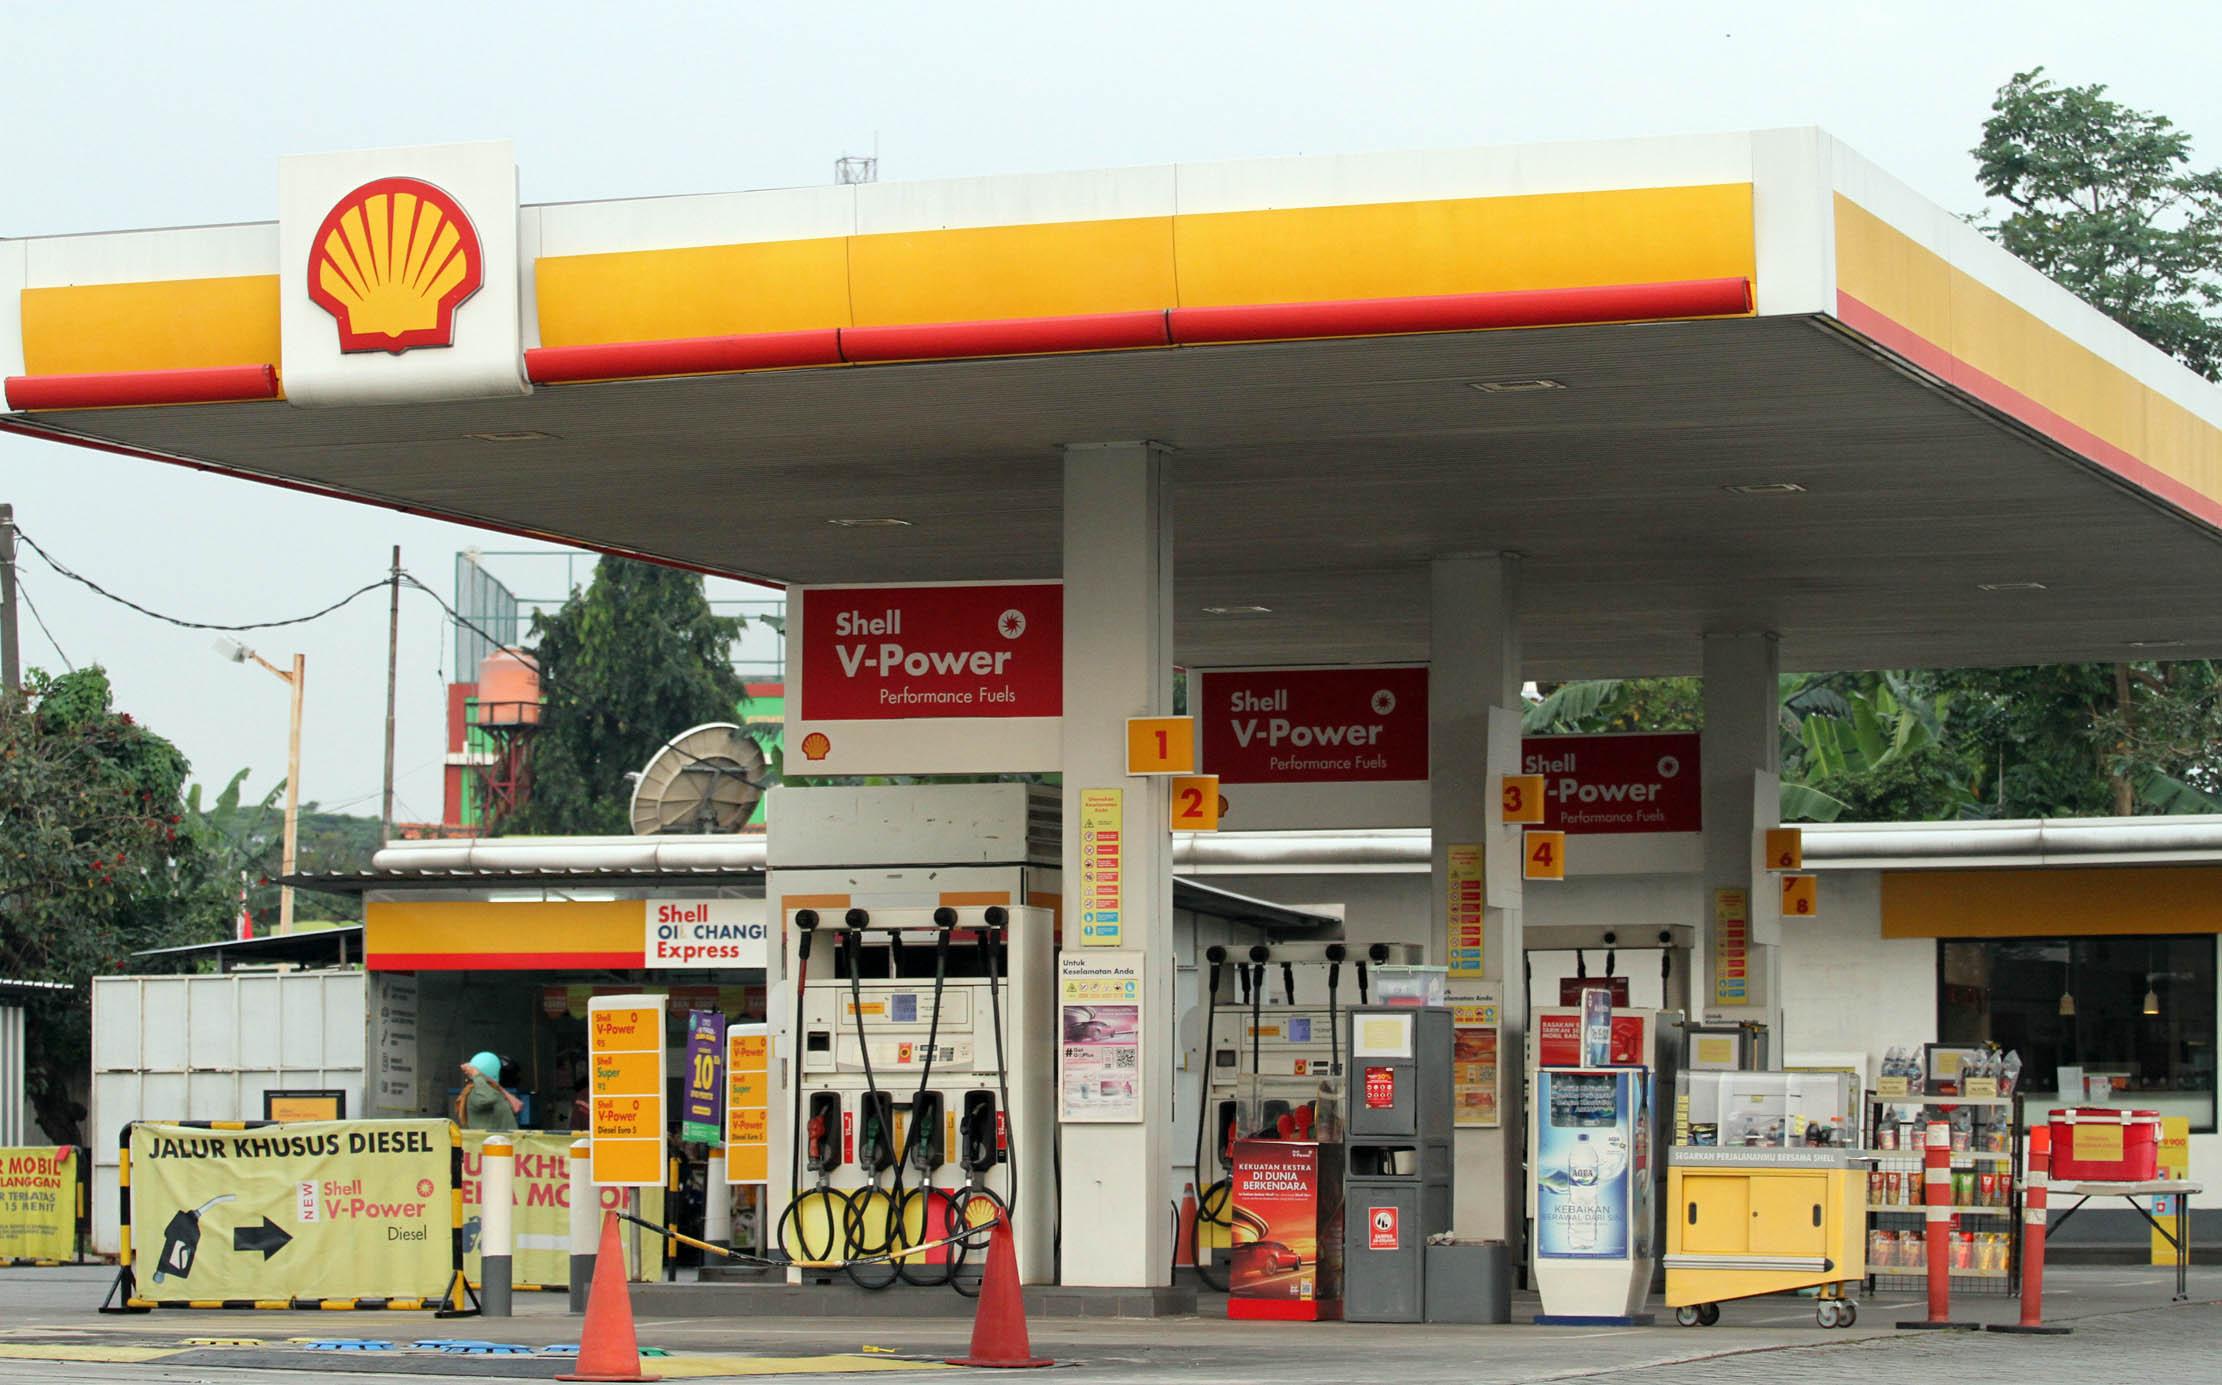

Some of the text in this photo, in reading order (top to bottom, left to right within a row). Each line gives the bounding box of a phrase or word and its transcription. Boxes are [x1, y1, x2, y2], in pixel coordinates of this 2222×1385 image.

[835, 609, 900, 636] Shell
[836, 643, 1012, 677] V-Power
[880, 685, 1016, 705] Performance Fuels
[1230, 689, 1287, 712] Shell
[1230, 718, 1384, 748] V-Power
[1155, 730, 1167, 759] 1
[1270, 756, 1388, 770] Performance Fuels
[1525, 753, 1576, 774] Shell
[1181, 788, 1203, 818] 2
[1503, 786, 1522, 812] 3
[1561, 808, 1665, 824] Performance Fuels
[1533, 842, 1552, 867] 4
[1780, 852, 1793, 867] 6
[1784, 876, 1798, 892] 7
[658, 904, 708, 923] Shell
[1797, 898, 1809, 914] 8
[694, 925, 767, 939] CHANG
[657, 941, 739, 963] Express
[596, 1013, 612, 1022] Shell
[597, 1023, 635, 1034] V-Power
[734, 1047, 765, 1057] V-Power
[597, 1056, 612, 1066] Shell
[597, 1067, 620, 1080] Super
[694, 1054, 714, 1090] 10
[598, 1100, 613, 1109] Shell
[599, 1110, 637, 1121] V-Power
[598, 1126, 616, 1135] Diesel
[733, 1120, 763, 1130] V-Power
[149, 1131, 433, 1159] JALUR KHUSUS DIESEL
[9, 1156, 61, 1176] MOBIL
[1814, 1154, 1835, 1162] SHELL
[1253, 1172, 1298, 1181] DI DUNIA
[324, 1180, 362, 1196] Shell
[1243, 1181, 1307, 1190] BERKENDARA
[303, 1183, 314, 1220] NEW
[527, 1183, 630, 1210] MOO
[324, 1199, 426, 1219] V-Power
[1554, 1205, 1611, 1214] KEBAIKAN
[388, 1224, 427, 1241] Diesel
